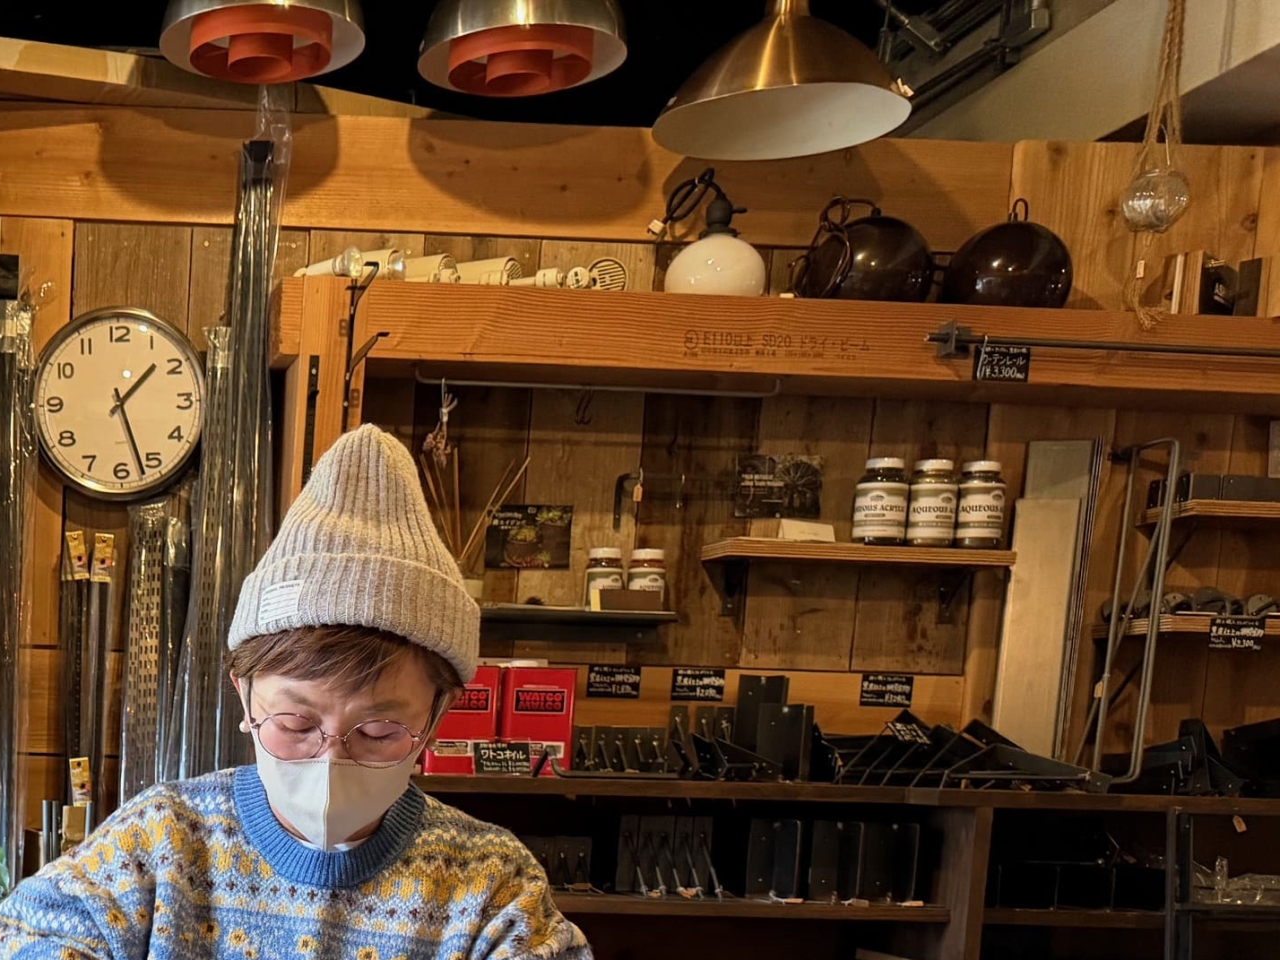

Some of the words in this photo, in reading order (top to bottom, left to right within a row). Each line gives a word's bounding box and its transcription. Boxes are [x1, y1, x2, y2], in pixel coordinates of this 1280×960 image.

[109, 326, 131, 343] 12
[80, 338, 93, 355] 11
[57, 362, 74, 379] 10
[166, 358, 183, 375] 2
[46, 397, 64, 413] 9
[176, 392, 193, 410] 3
[58, 430, 76, 447] 8
[167, 426, 184, 442] 4
[82, 455, 97, 472] 7
[145, 452, 162, 468] 5
[113, 463, 130, 479] 6
[518, 692, 562, 701] WATCO
